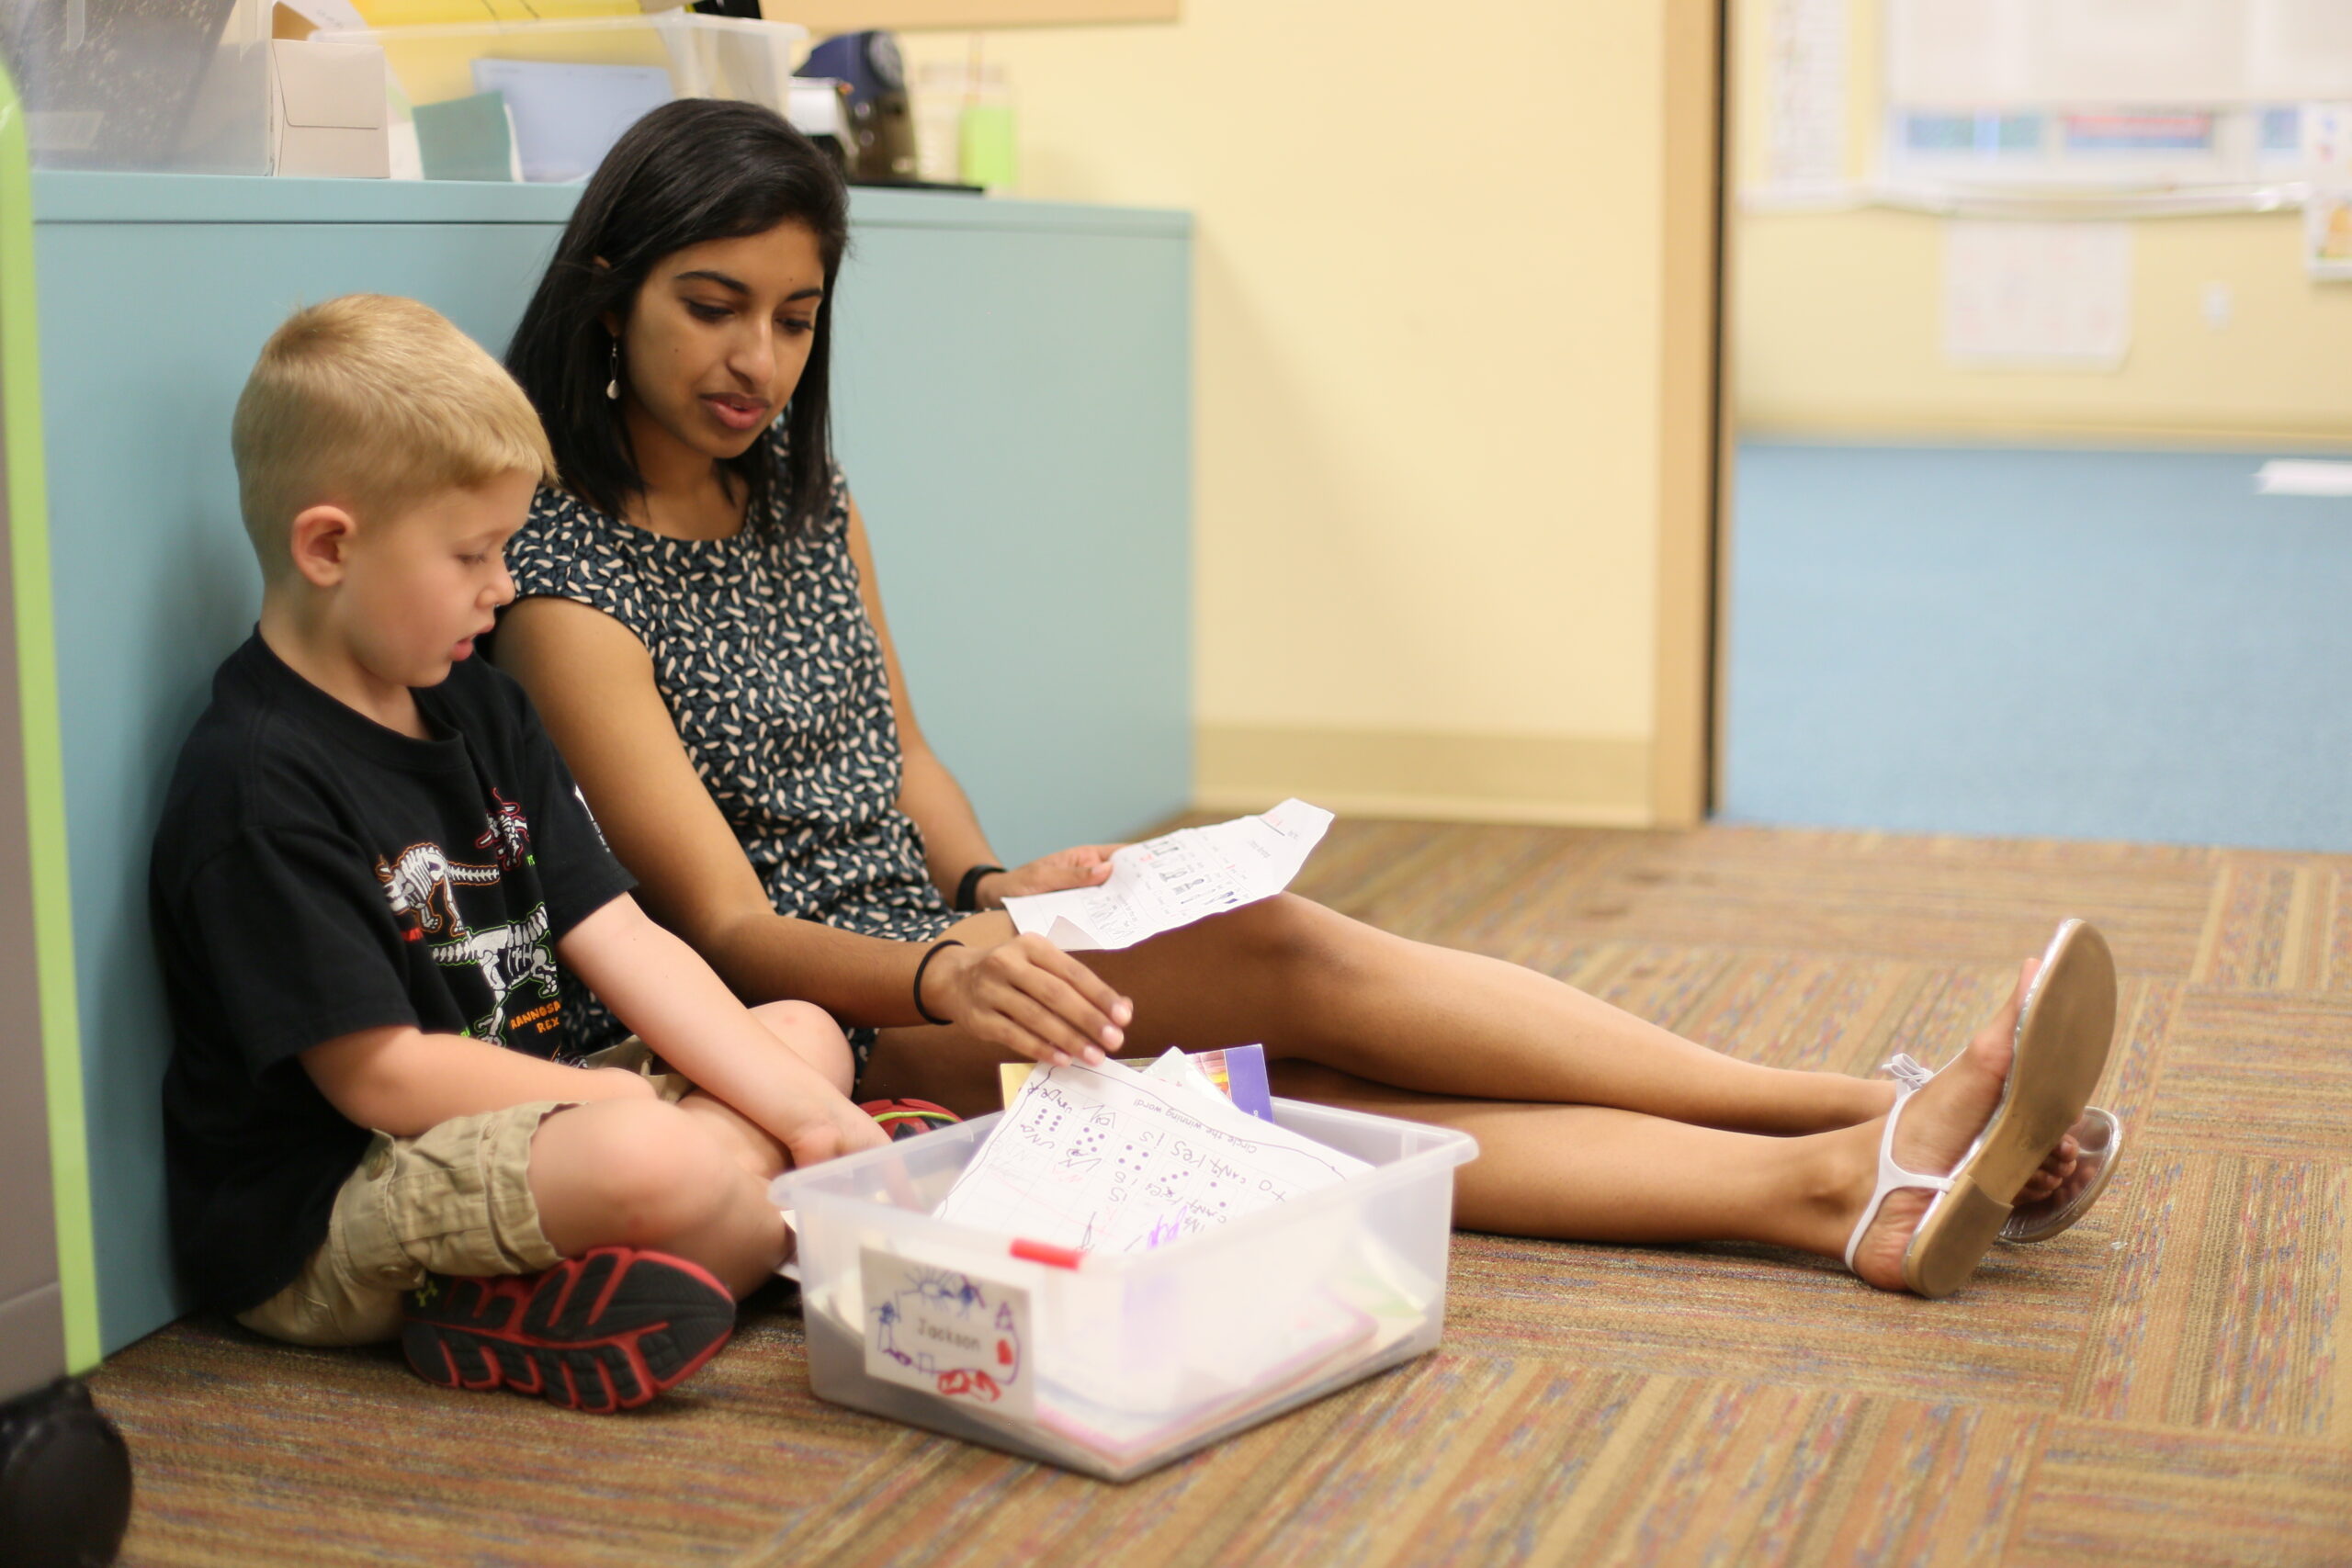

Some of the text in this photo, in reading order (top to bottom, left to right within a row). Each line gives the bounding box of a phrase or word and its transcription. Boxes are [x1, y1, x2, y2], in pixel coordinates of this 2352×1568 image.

[537, 1017, 559, 1033] REX
[1133, 1098, 1257, 1154] Circle the winning word!
[918, 1316, 980, 1351] Jackson
